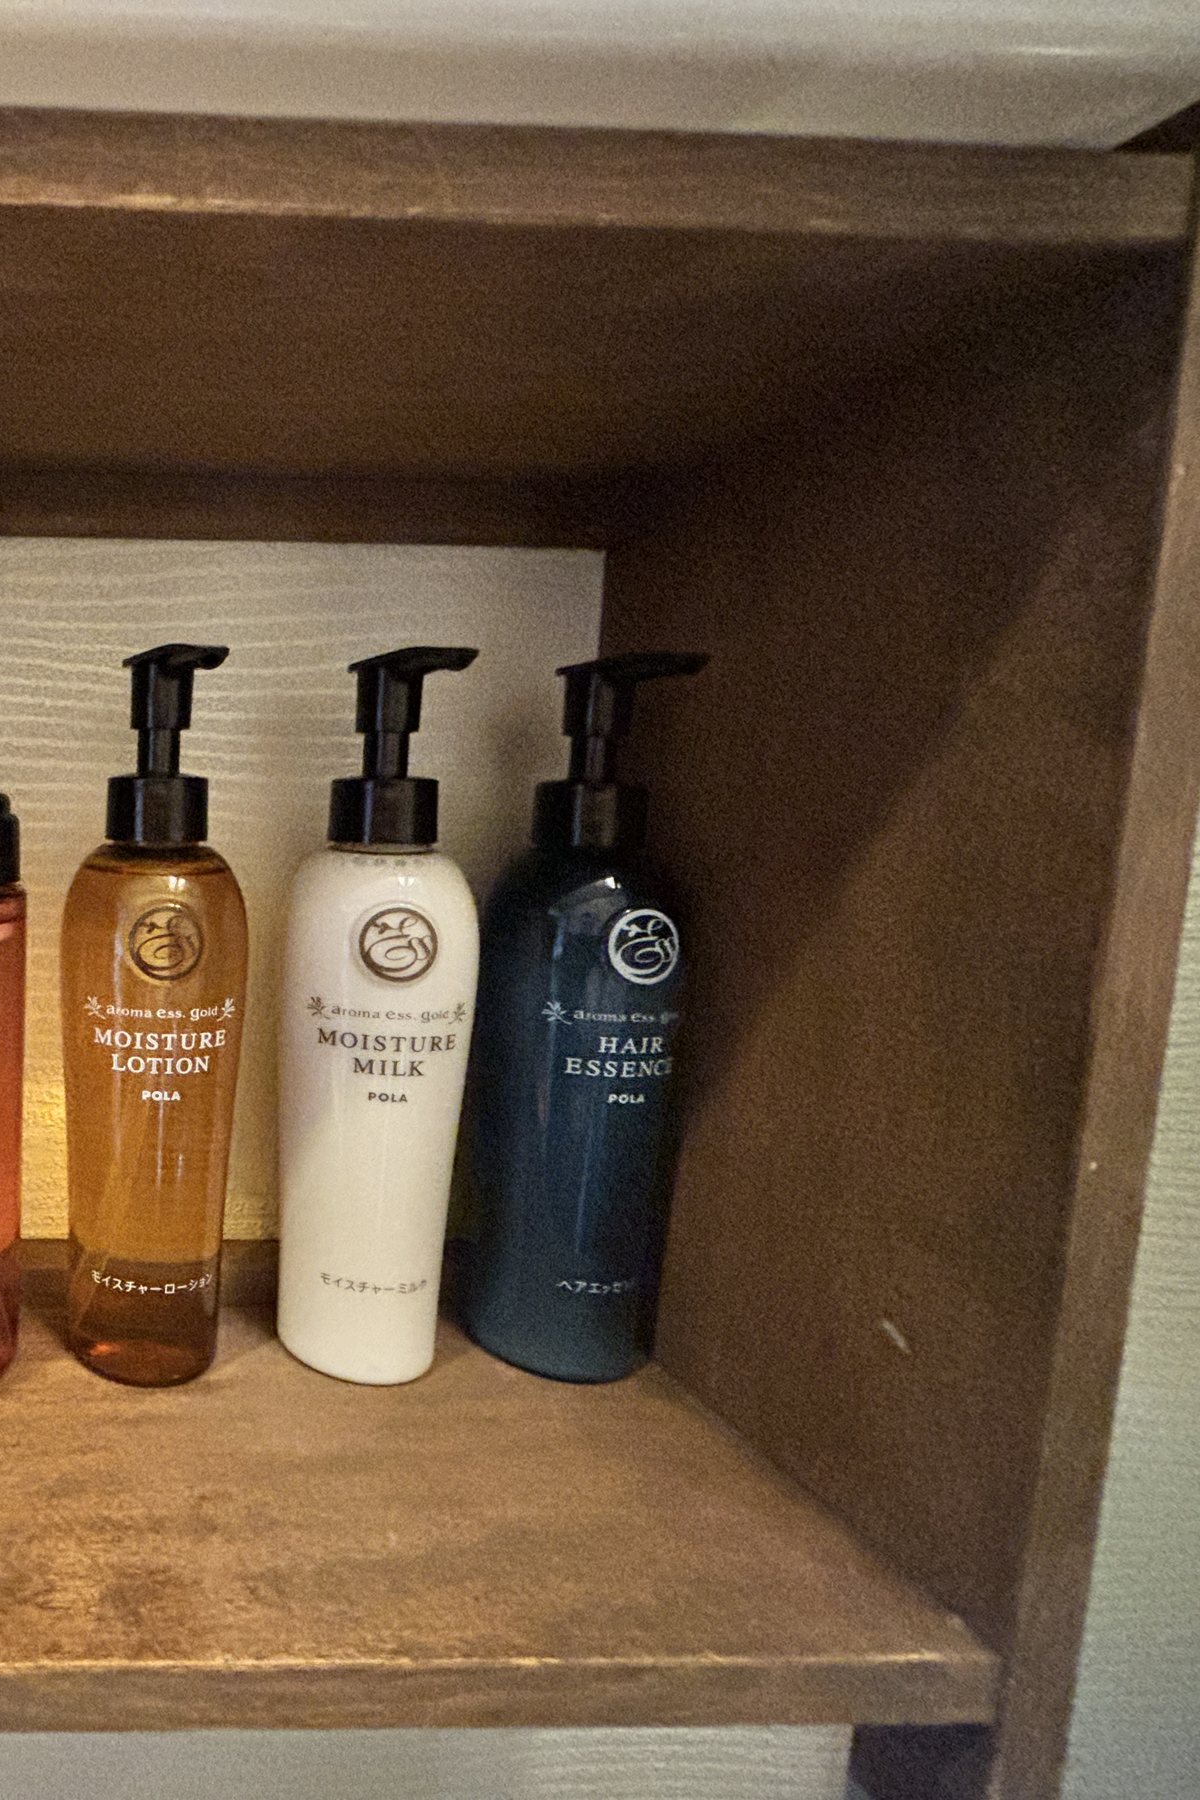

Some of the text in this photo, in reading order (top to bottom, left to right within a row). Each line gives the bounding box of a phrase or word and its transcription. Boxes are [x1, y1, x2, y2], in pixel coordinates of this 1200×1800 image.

[106, 1004, 218, 1021] aroma ess. gold
[331, 1005, 380, 1019] aroma
[93, 1027, 226, 1051] MOISTURE
[317, 1027, 456, 1053] MOISTURE
[597, 1036, 664, 1054] HAIR
[111, 1053, 210, 1076] LOTION
[353, 1057, 424, 1077] MILK
[141, 1090, 181, 1101] POLA
[368, 1091, 408, 1103] POLA
[607, 1093, 645, 1104] POLA
[91, 1270, 213, 1295] モイスチャーローション
[556, 1278, 635, 1295] ヘアエッセ
